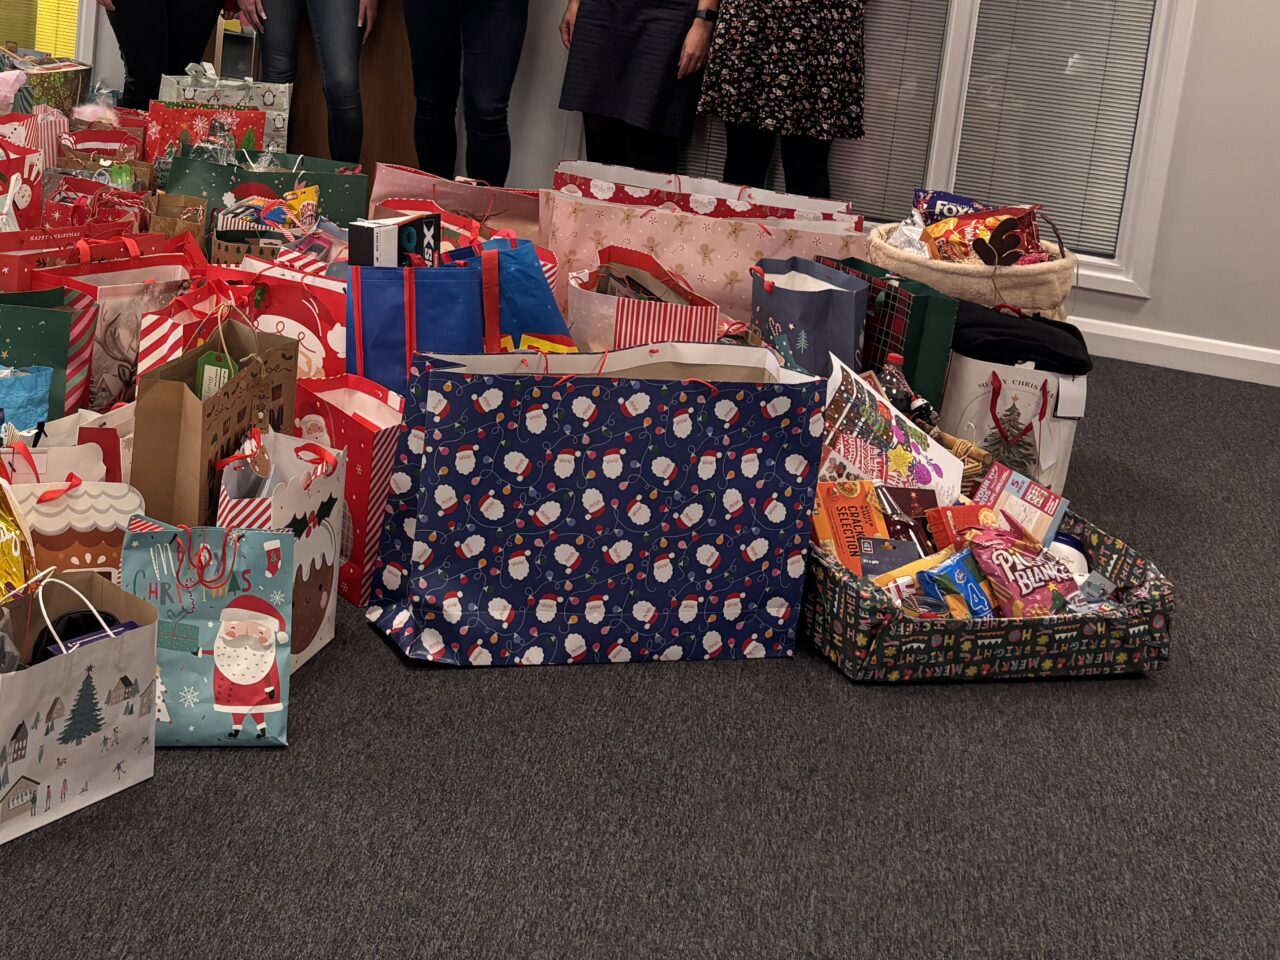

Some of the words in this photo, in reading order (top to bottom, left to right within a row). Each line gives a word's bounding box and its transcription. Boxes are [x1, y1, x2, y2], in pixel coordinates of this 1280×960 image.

[977, 377, 1008, 390] MEY
[1010, 478, 1020, 489] 5
[836, 505, 861, 558] SELECTION
[847, 505, 865, 538] CRACK
[1014, 560, 1073, 597] BLANK
[967, 582, 989, 611] 4
